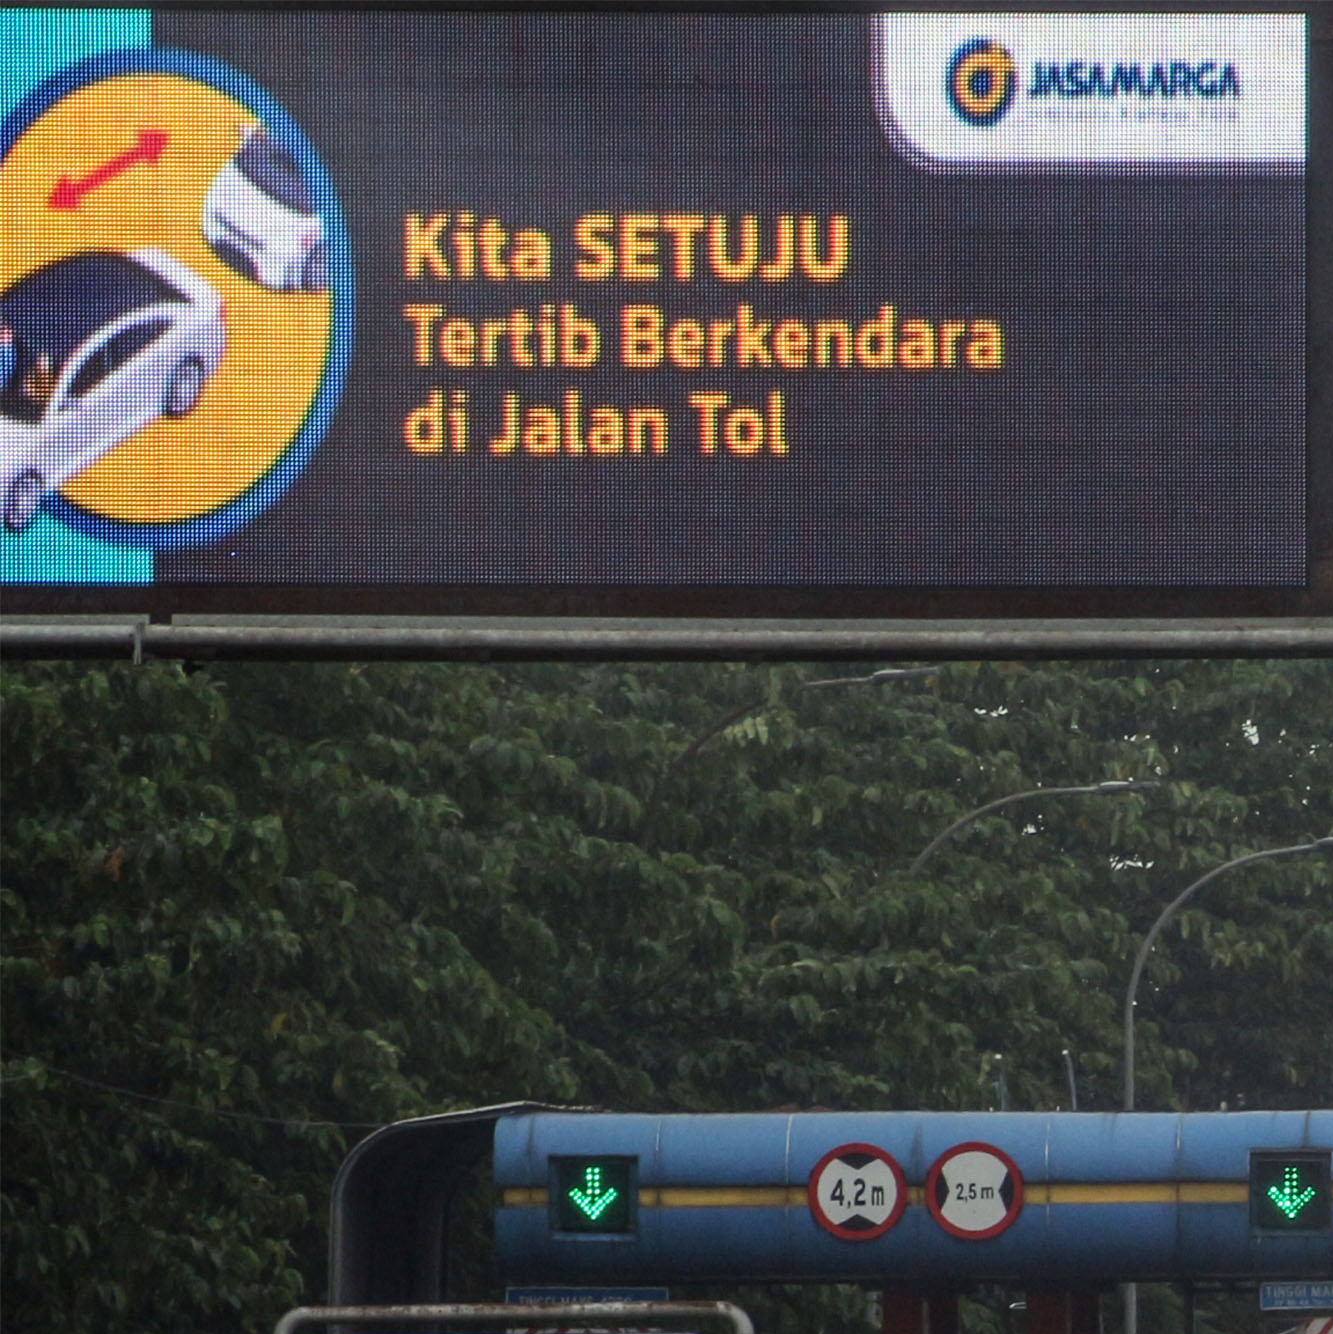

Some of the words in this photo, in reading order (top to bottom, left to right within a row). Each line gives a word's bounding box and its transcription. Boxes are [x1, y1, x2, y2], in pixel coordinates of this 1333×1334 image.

[1027, 57, 1240, 98] JASAMARGA
[404, 211, 552, 281] Kita
[575, 213, 850, 282] SETUJU
[403, 302, 602, 369] Tertib
[620, 302, 1004, 370] Berkendara
[403, 388, 469, 455] di
[489, 388, 670, 455] Jalan
[688, 389, 790, 455] Tol
